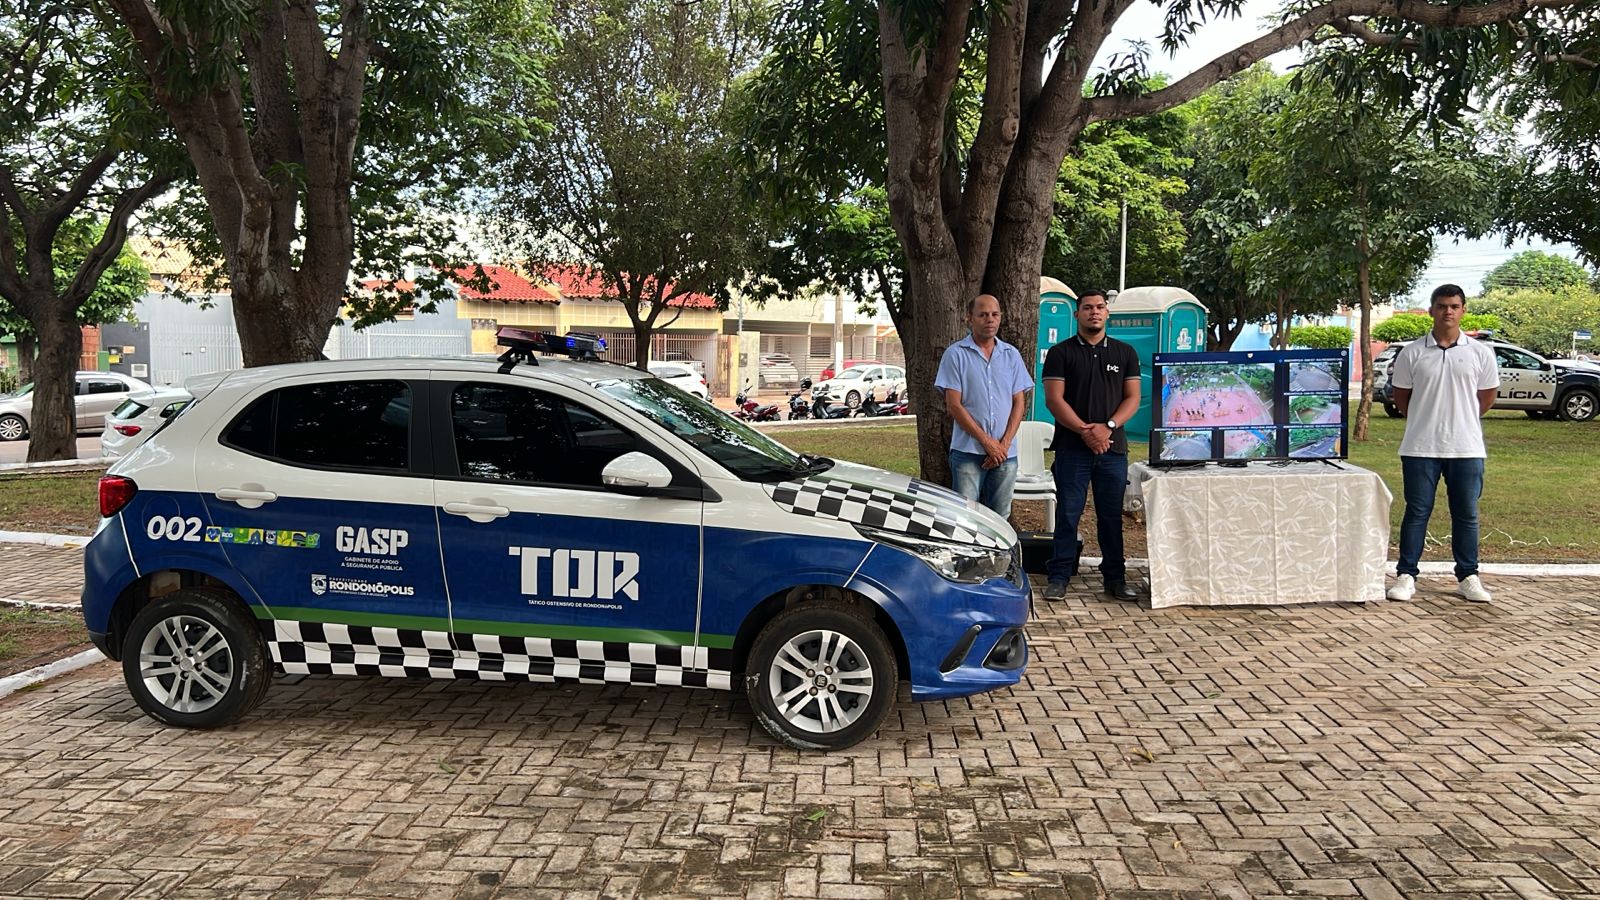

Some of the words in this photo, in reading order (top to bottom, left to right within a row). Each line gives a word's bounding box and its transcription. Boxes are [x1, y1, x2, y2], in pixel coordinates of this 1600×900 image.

[1497, 388, 1547, 399] LÍCIA
[147, 515, 202, 541] 002
[336, 526, 408, 555] GASP
[508, 546, 639, 600] TOR
[329, 581, 414, 595] RONDONÓPOLIS
